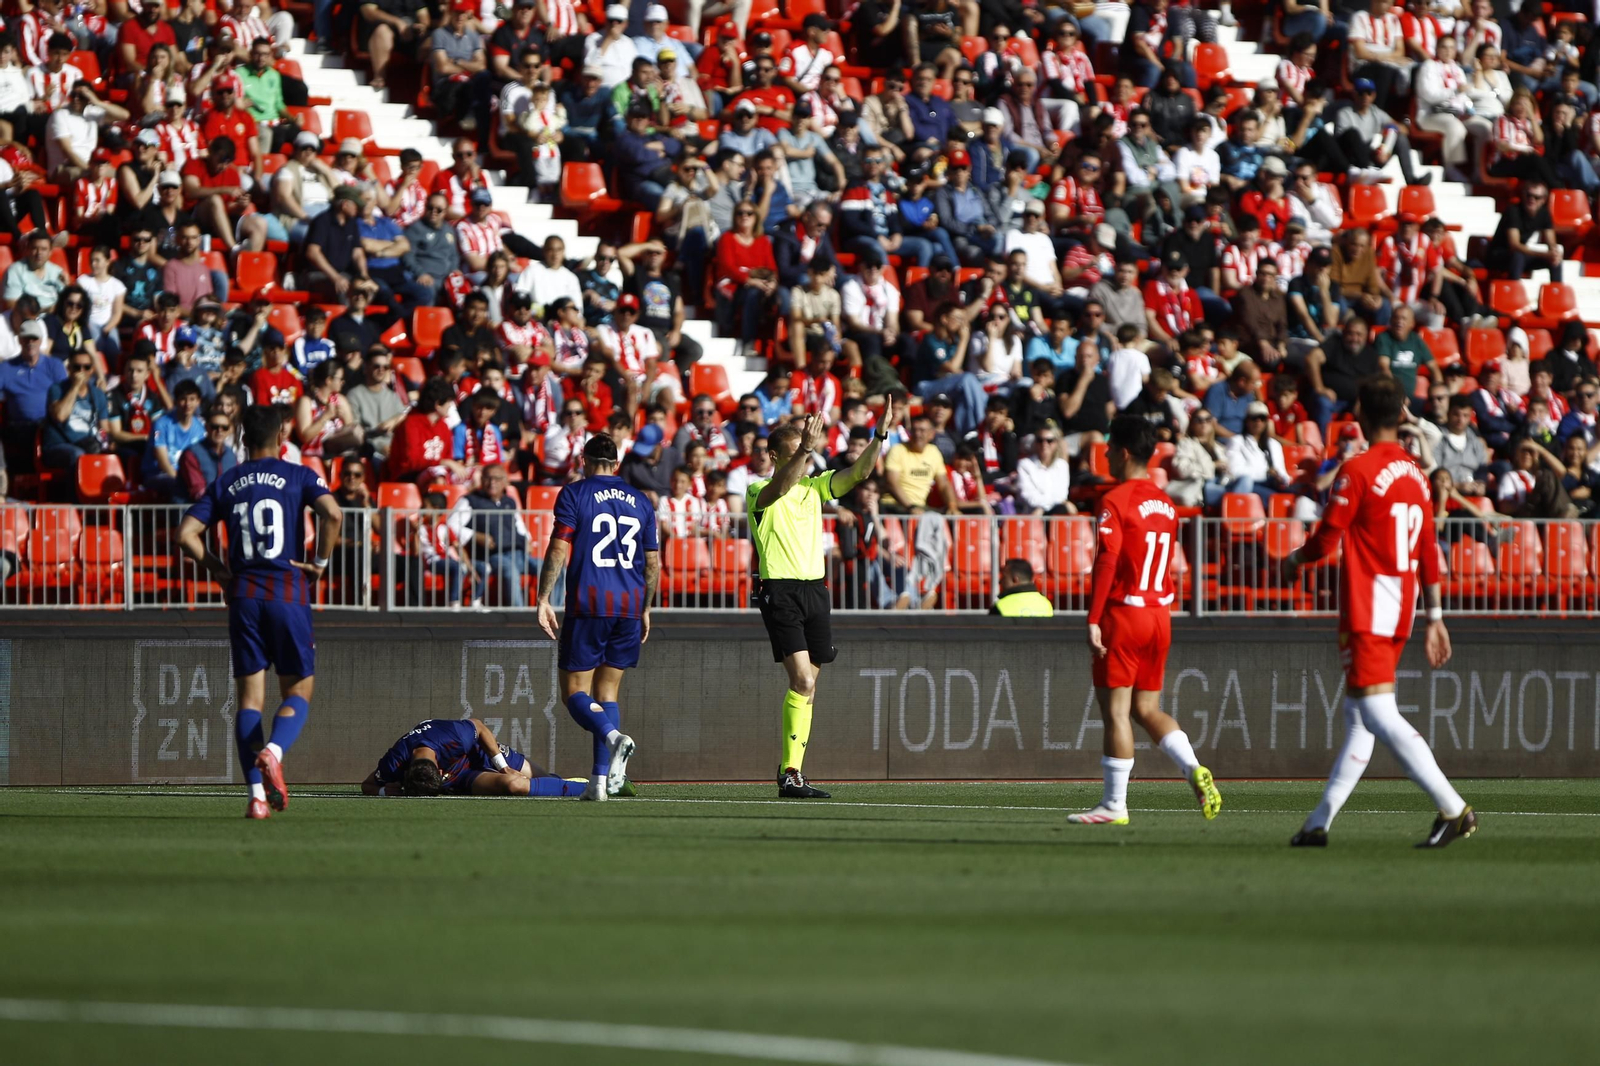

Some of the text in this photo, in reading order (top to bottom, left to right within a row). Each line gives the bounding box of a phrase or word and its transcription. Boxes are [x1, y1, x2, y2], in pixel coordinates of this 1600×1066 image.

[228, 472, 287, 496] FEDE VICO
[593, 488, 637, 509] MARC M.
[1138, 499, 1176, 520] ARRIBAS
[1371, 467, 1394, 498] LEO
[232, 498, 285, 560] 19
[591, 512, 641, 570] 23
[1389, 502, 1424, 574] 12
[1138, 531, 1171, 592] 11
[859, 667, 1024, 752] TODA
